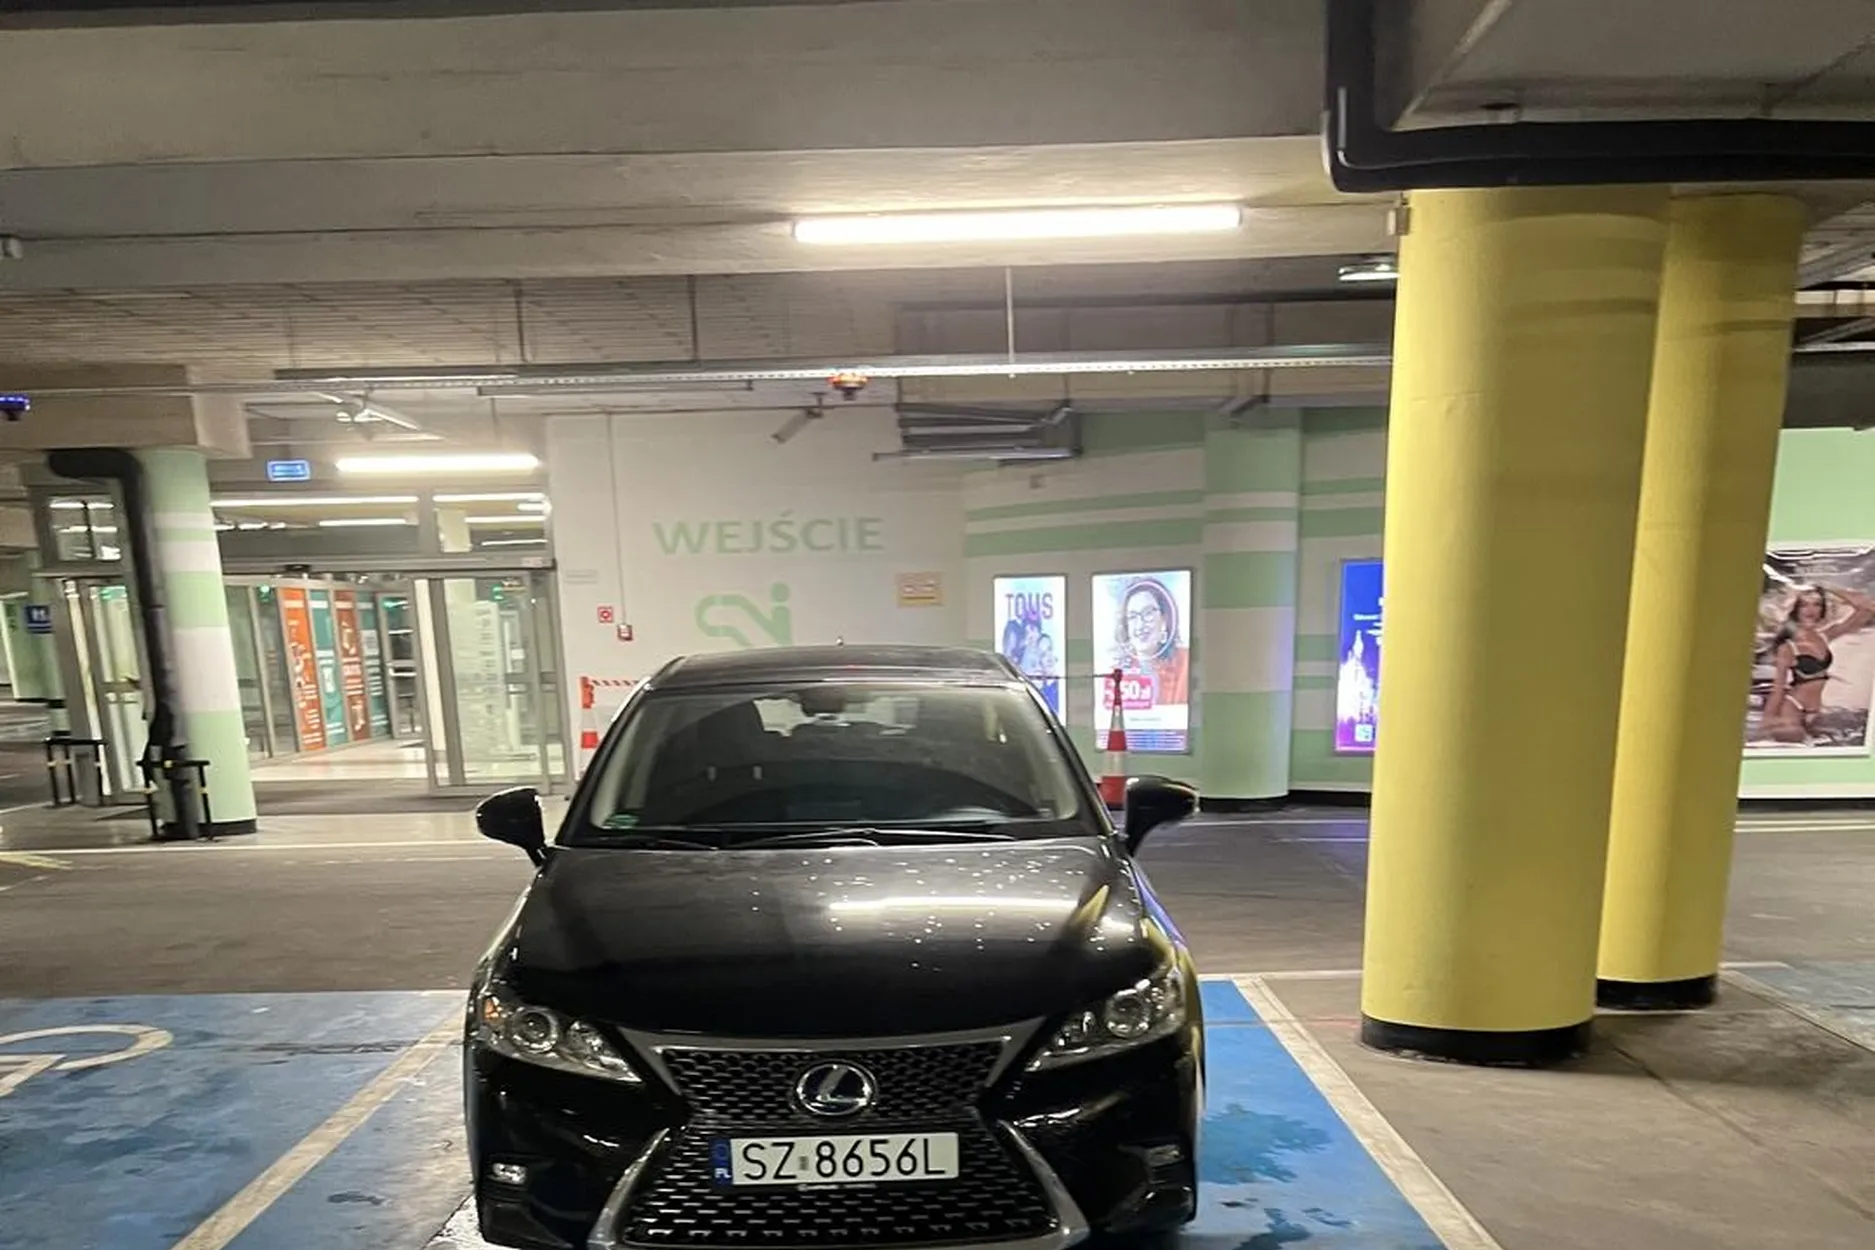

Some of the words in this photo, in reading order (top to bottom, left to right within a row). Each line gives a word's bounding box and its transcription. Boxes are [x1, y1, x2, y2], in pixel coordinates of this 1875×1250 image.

[652, 510, 886, 555] WEJŚCIE
[1005, 592, 1053, 620] TOUS
[743, 1142, 797, 1180] SZ
[816, 1138, 946, 1177] 8656L
